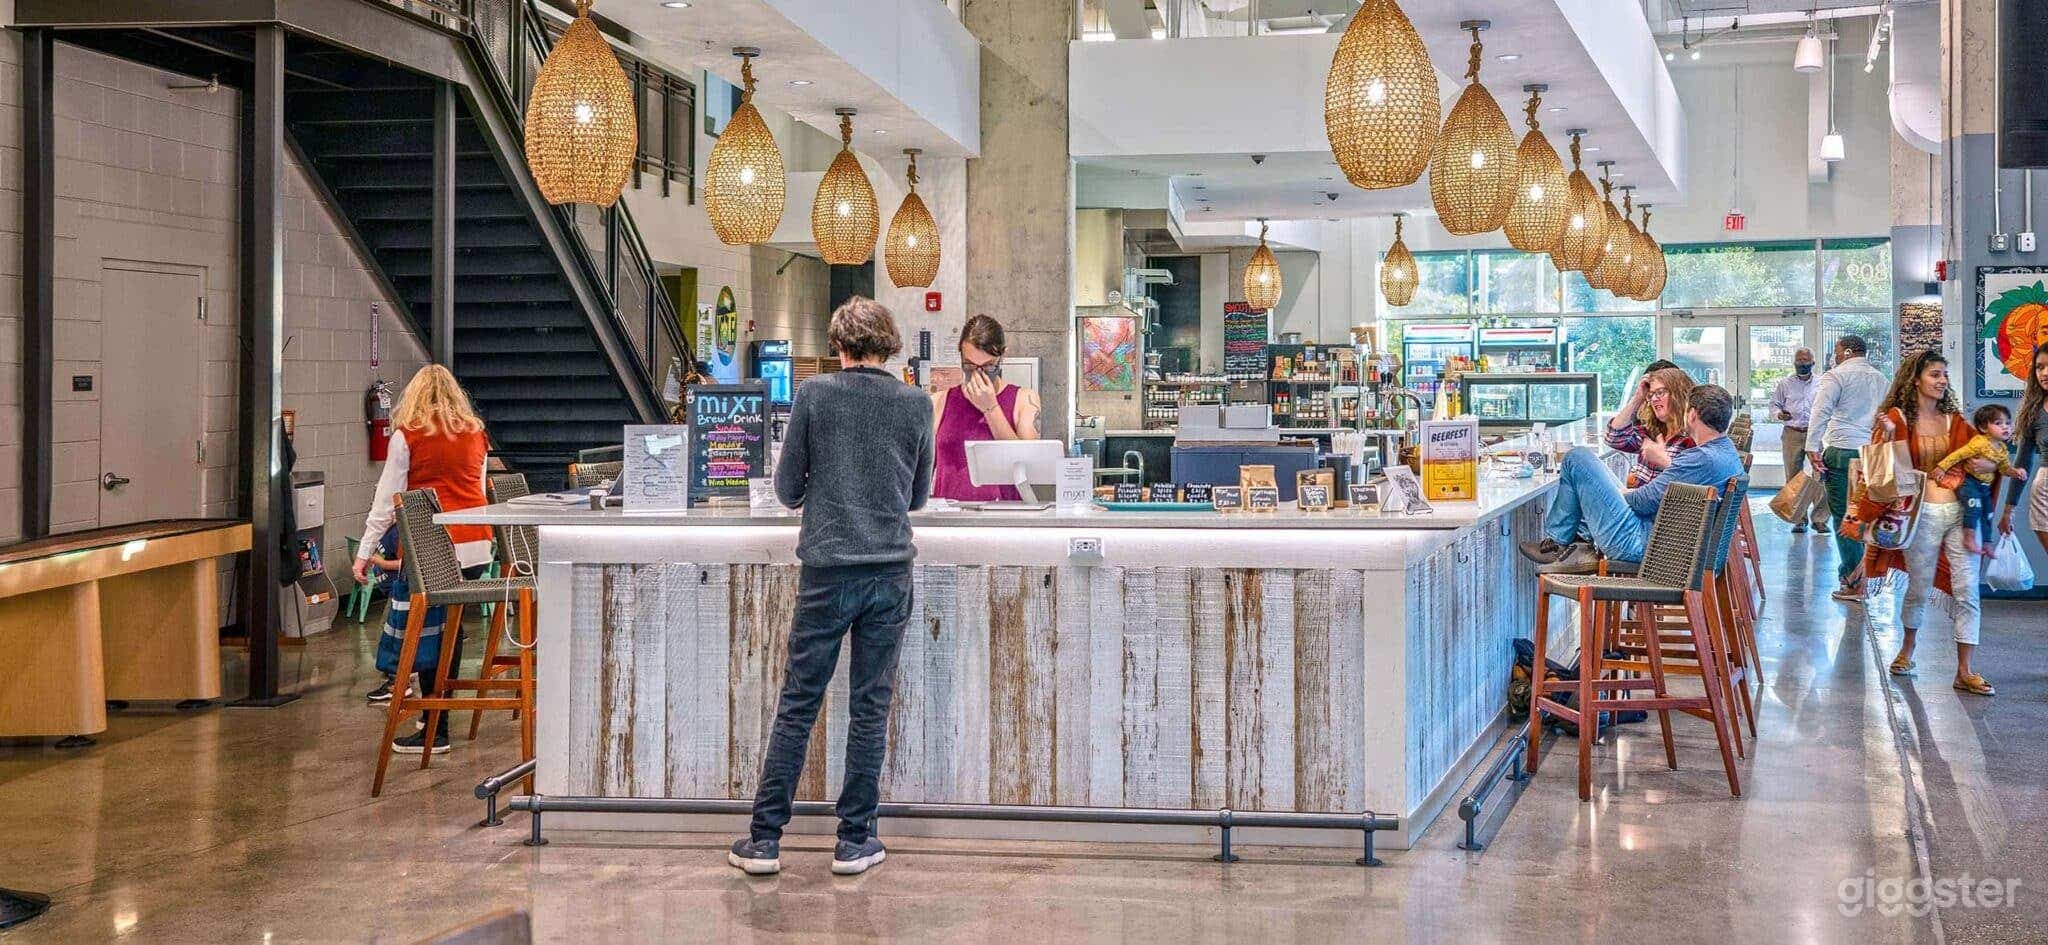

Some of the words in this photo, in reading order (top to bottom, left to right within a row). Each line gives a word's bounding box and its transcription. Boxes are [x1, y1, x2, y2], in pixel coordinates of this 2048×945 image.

[1725, 215, 1744, 230] EXIT
[697, 414, 727, 425] Brew
[1431, 428, 1469, 442] BEERFEST
